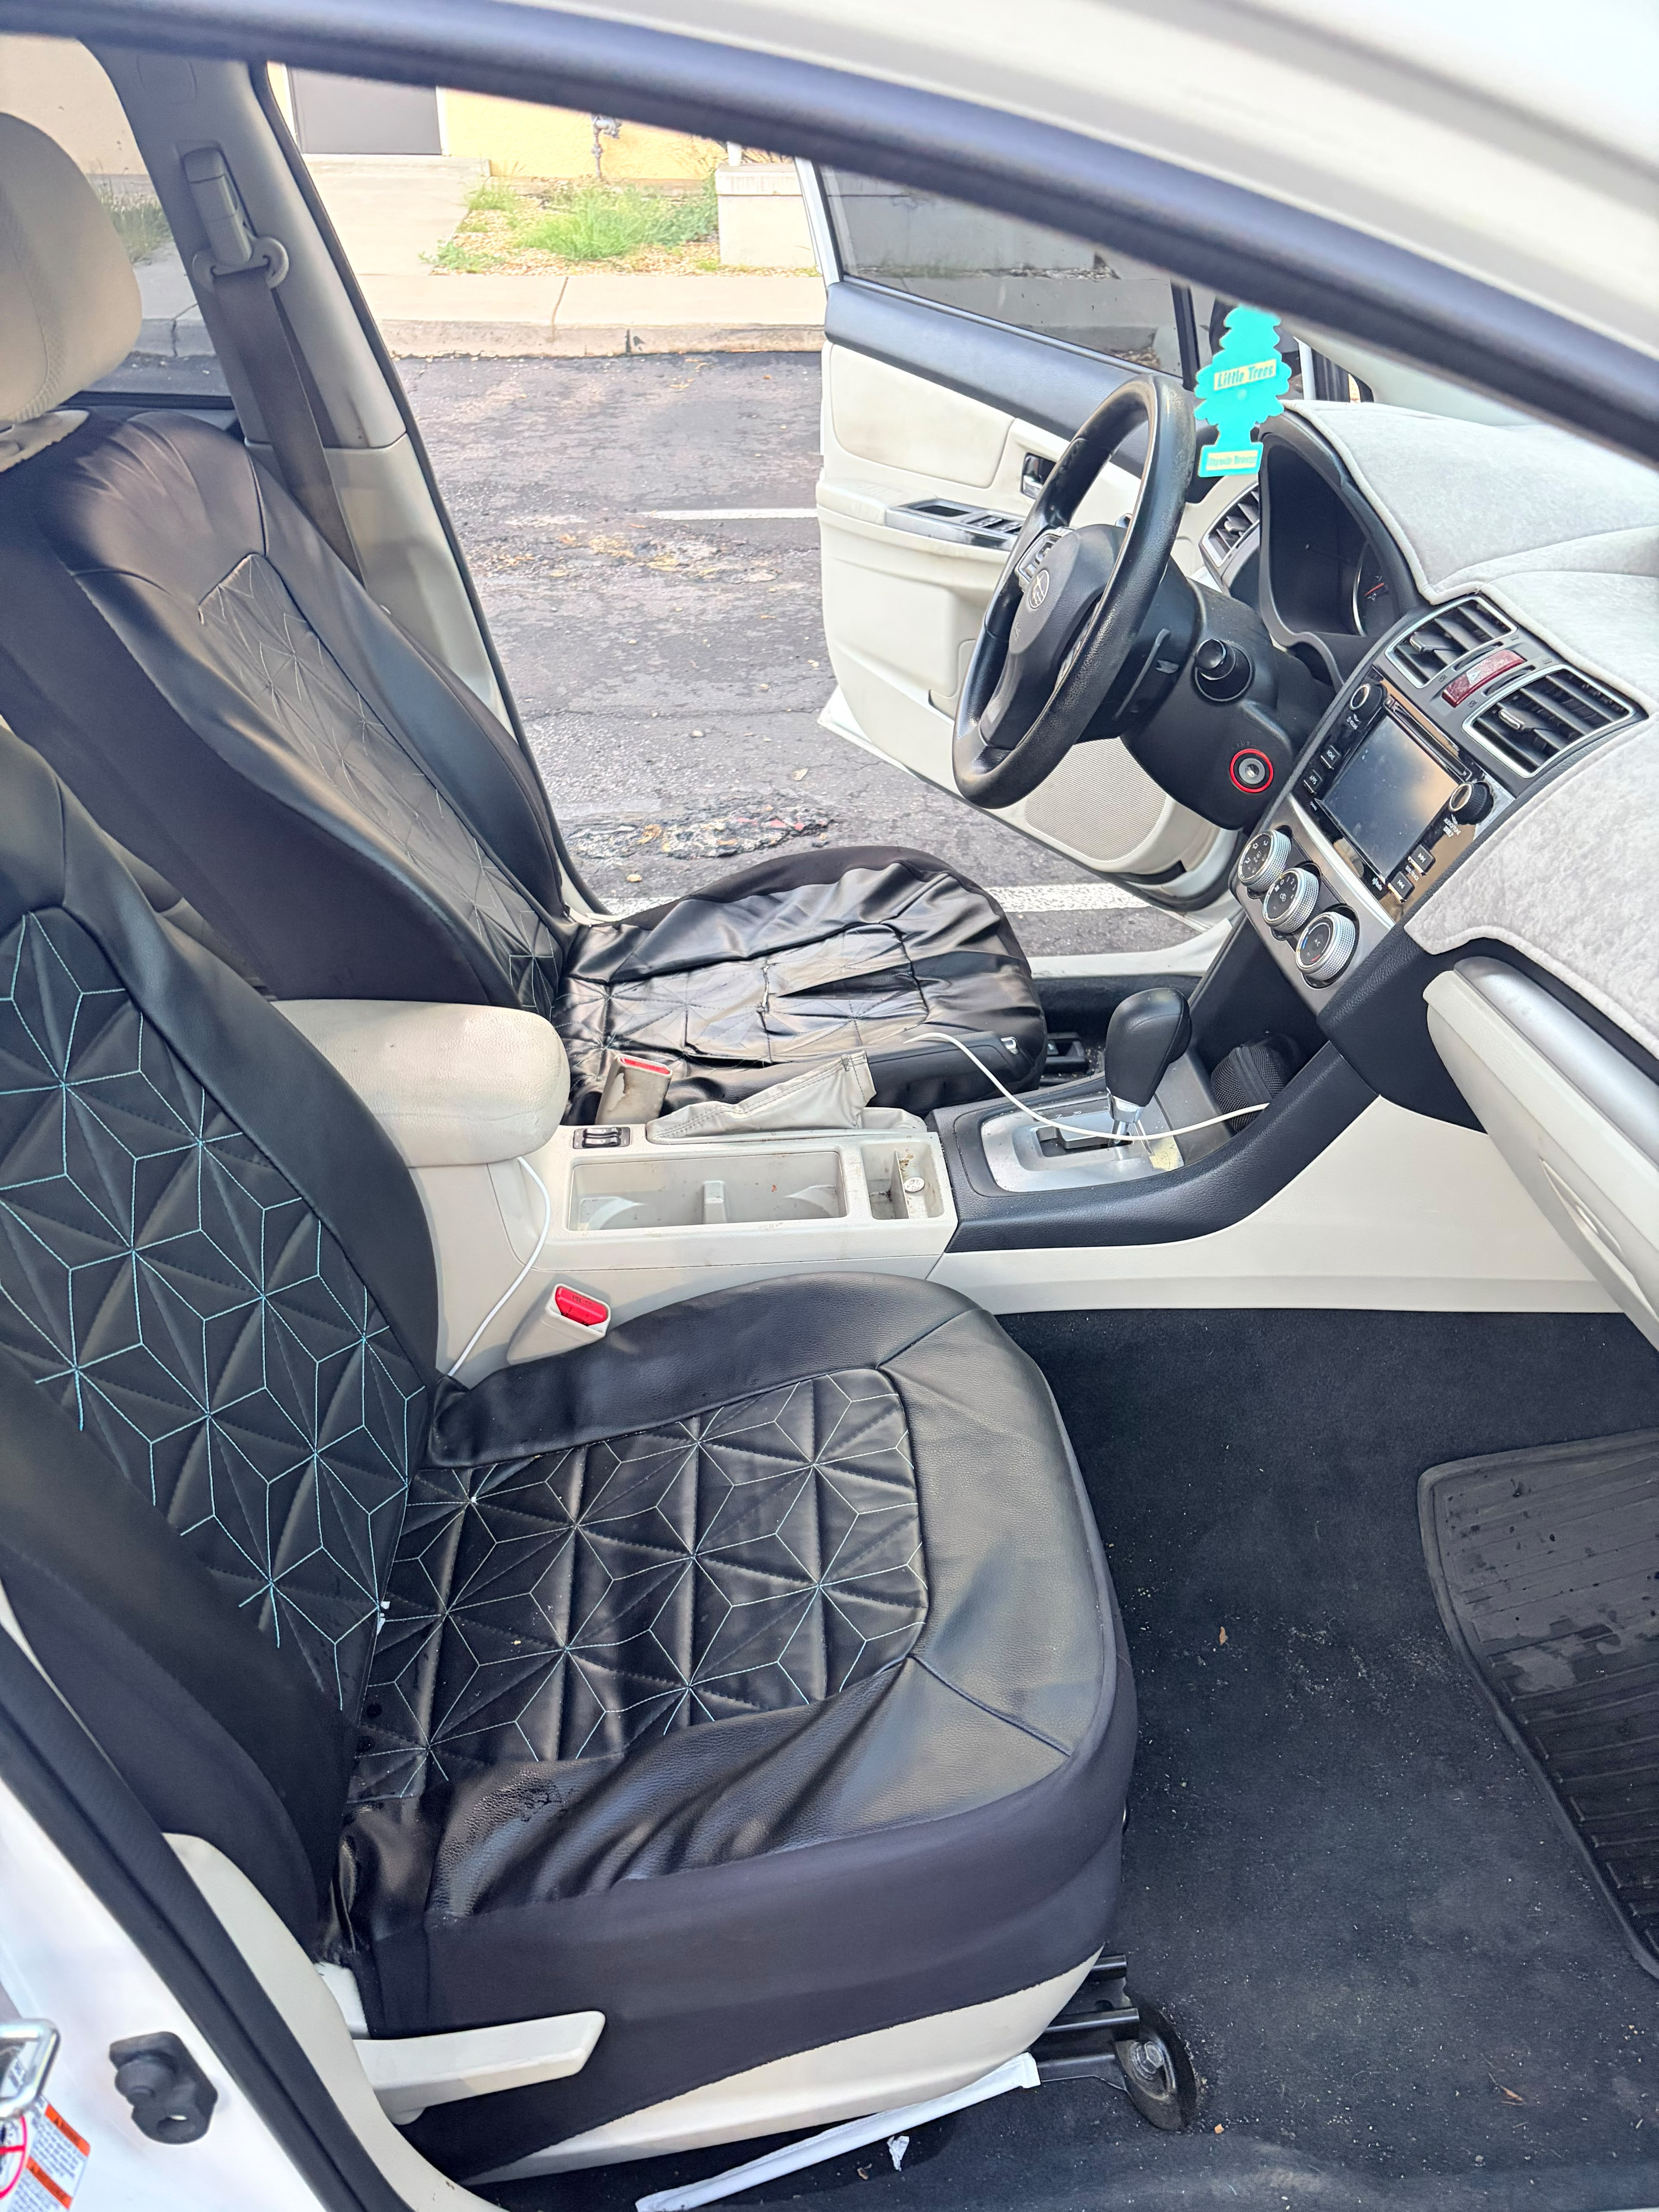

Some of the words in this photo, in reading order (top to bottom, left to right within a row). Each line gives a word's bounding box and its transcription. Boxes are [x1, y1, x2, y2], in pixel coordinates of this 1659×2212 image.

[1217, 370, 1245, 388] Little
[1248, 365, 1274, 380] Trees
[1326, 750, 1335, 760] HOME
[1309, 775, 1318, 785] APPS
[1443, 817, 1462, 836] AUDIO/TUNE
[1405, 865, 1419, 882] SEEK/TRACK
